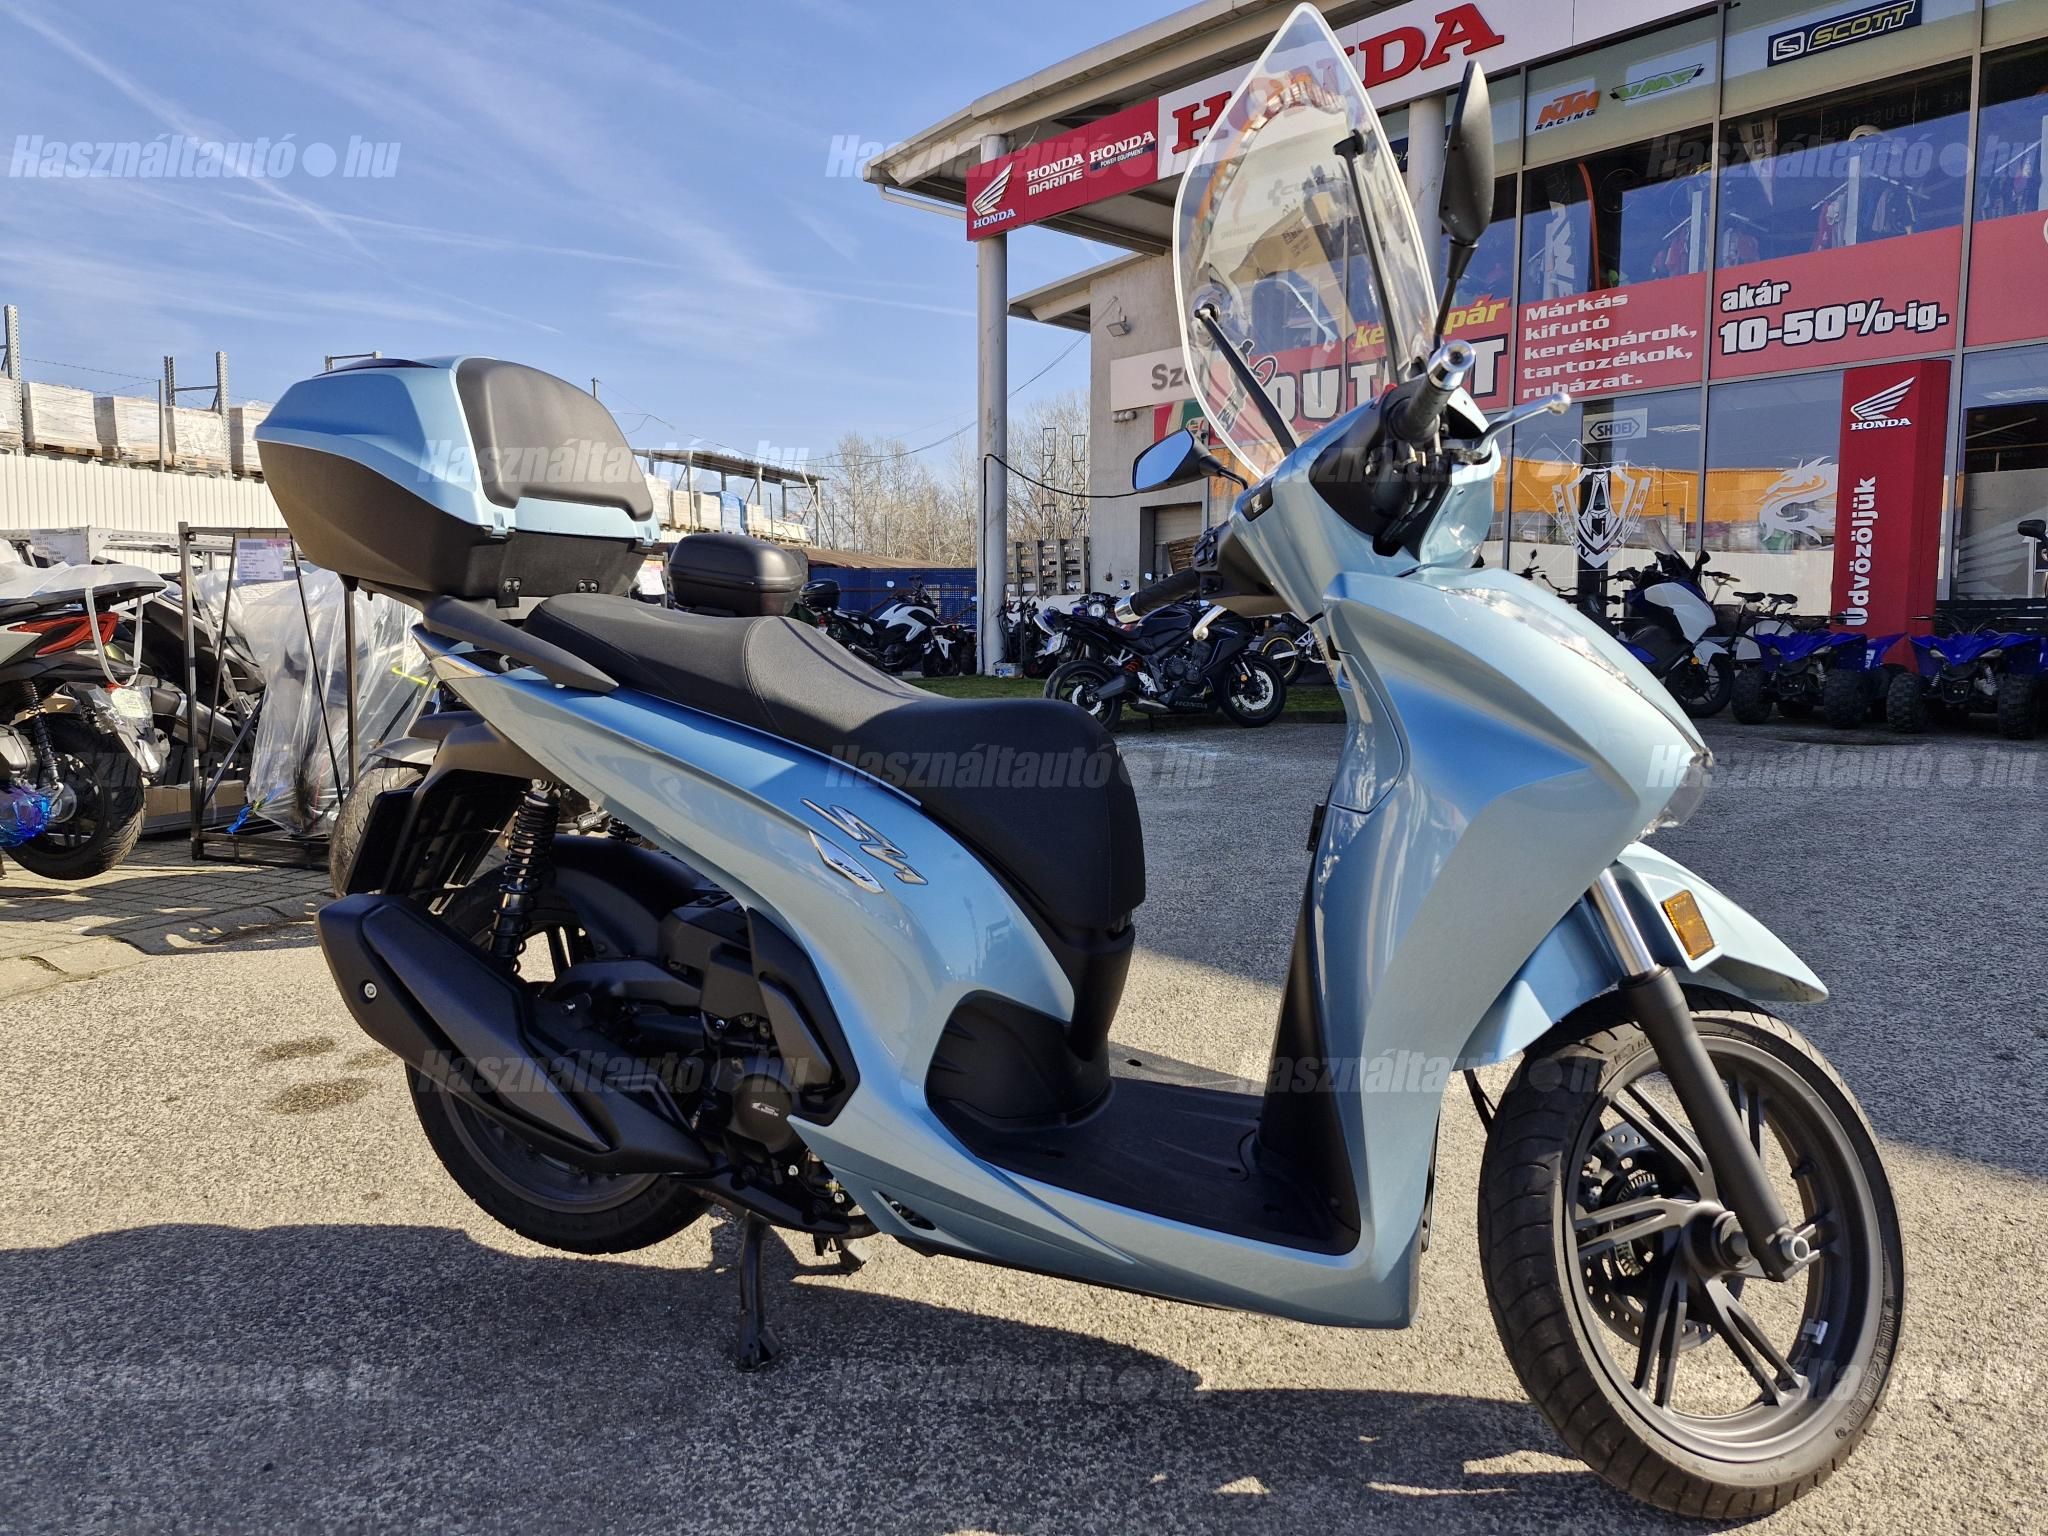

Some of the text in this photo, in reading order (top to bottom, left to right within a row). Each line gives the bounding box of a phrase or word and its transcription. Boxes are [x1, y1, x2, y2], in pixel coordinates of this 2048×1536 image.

[1813, 4, 1909, 46] SCOTT
[1535, 108, 1597, 132] RACING
[1537, 89, 1600, 124] KTM
[1089, 131, 1157, 163] HONDA
[1100, 148, 1144, 168] POWER EQUIPMENT
[1027, 152, 1085, 182] HONDA
[1028, 170, 1084, 197] MARINE
[972, 208, 1017, 230] HONDA
[1525, 294, 1629, 322] Márkás
[1722, 280, 1790, 311] akár
[1525, 315, 1610, 341] kifutó
[1720, 300, 1948, 354] 10-50%-ig.
[1524, 324, 1698, 361] kerékpárok,
[1523, 345, 1694, 380] tartozékok,
[1523, 373, 1643, 399] ruházat.
[1597, 421, 1634, 437] SHOEI
[1850, 417, 1912, 431] HONDA
